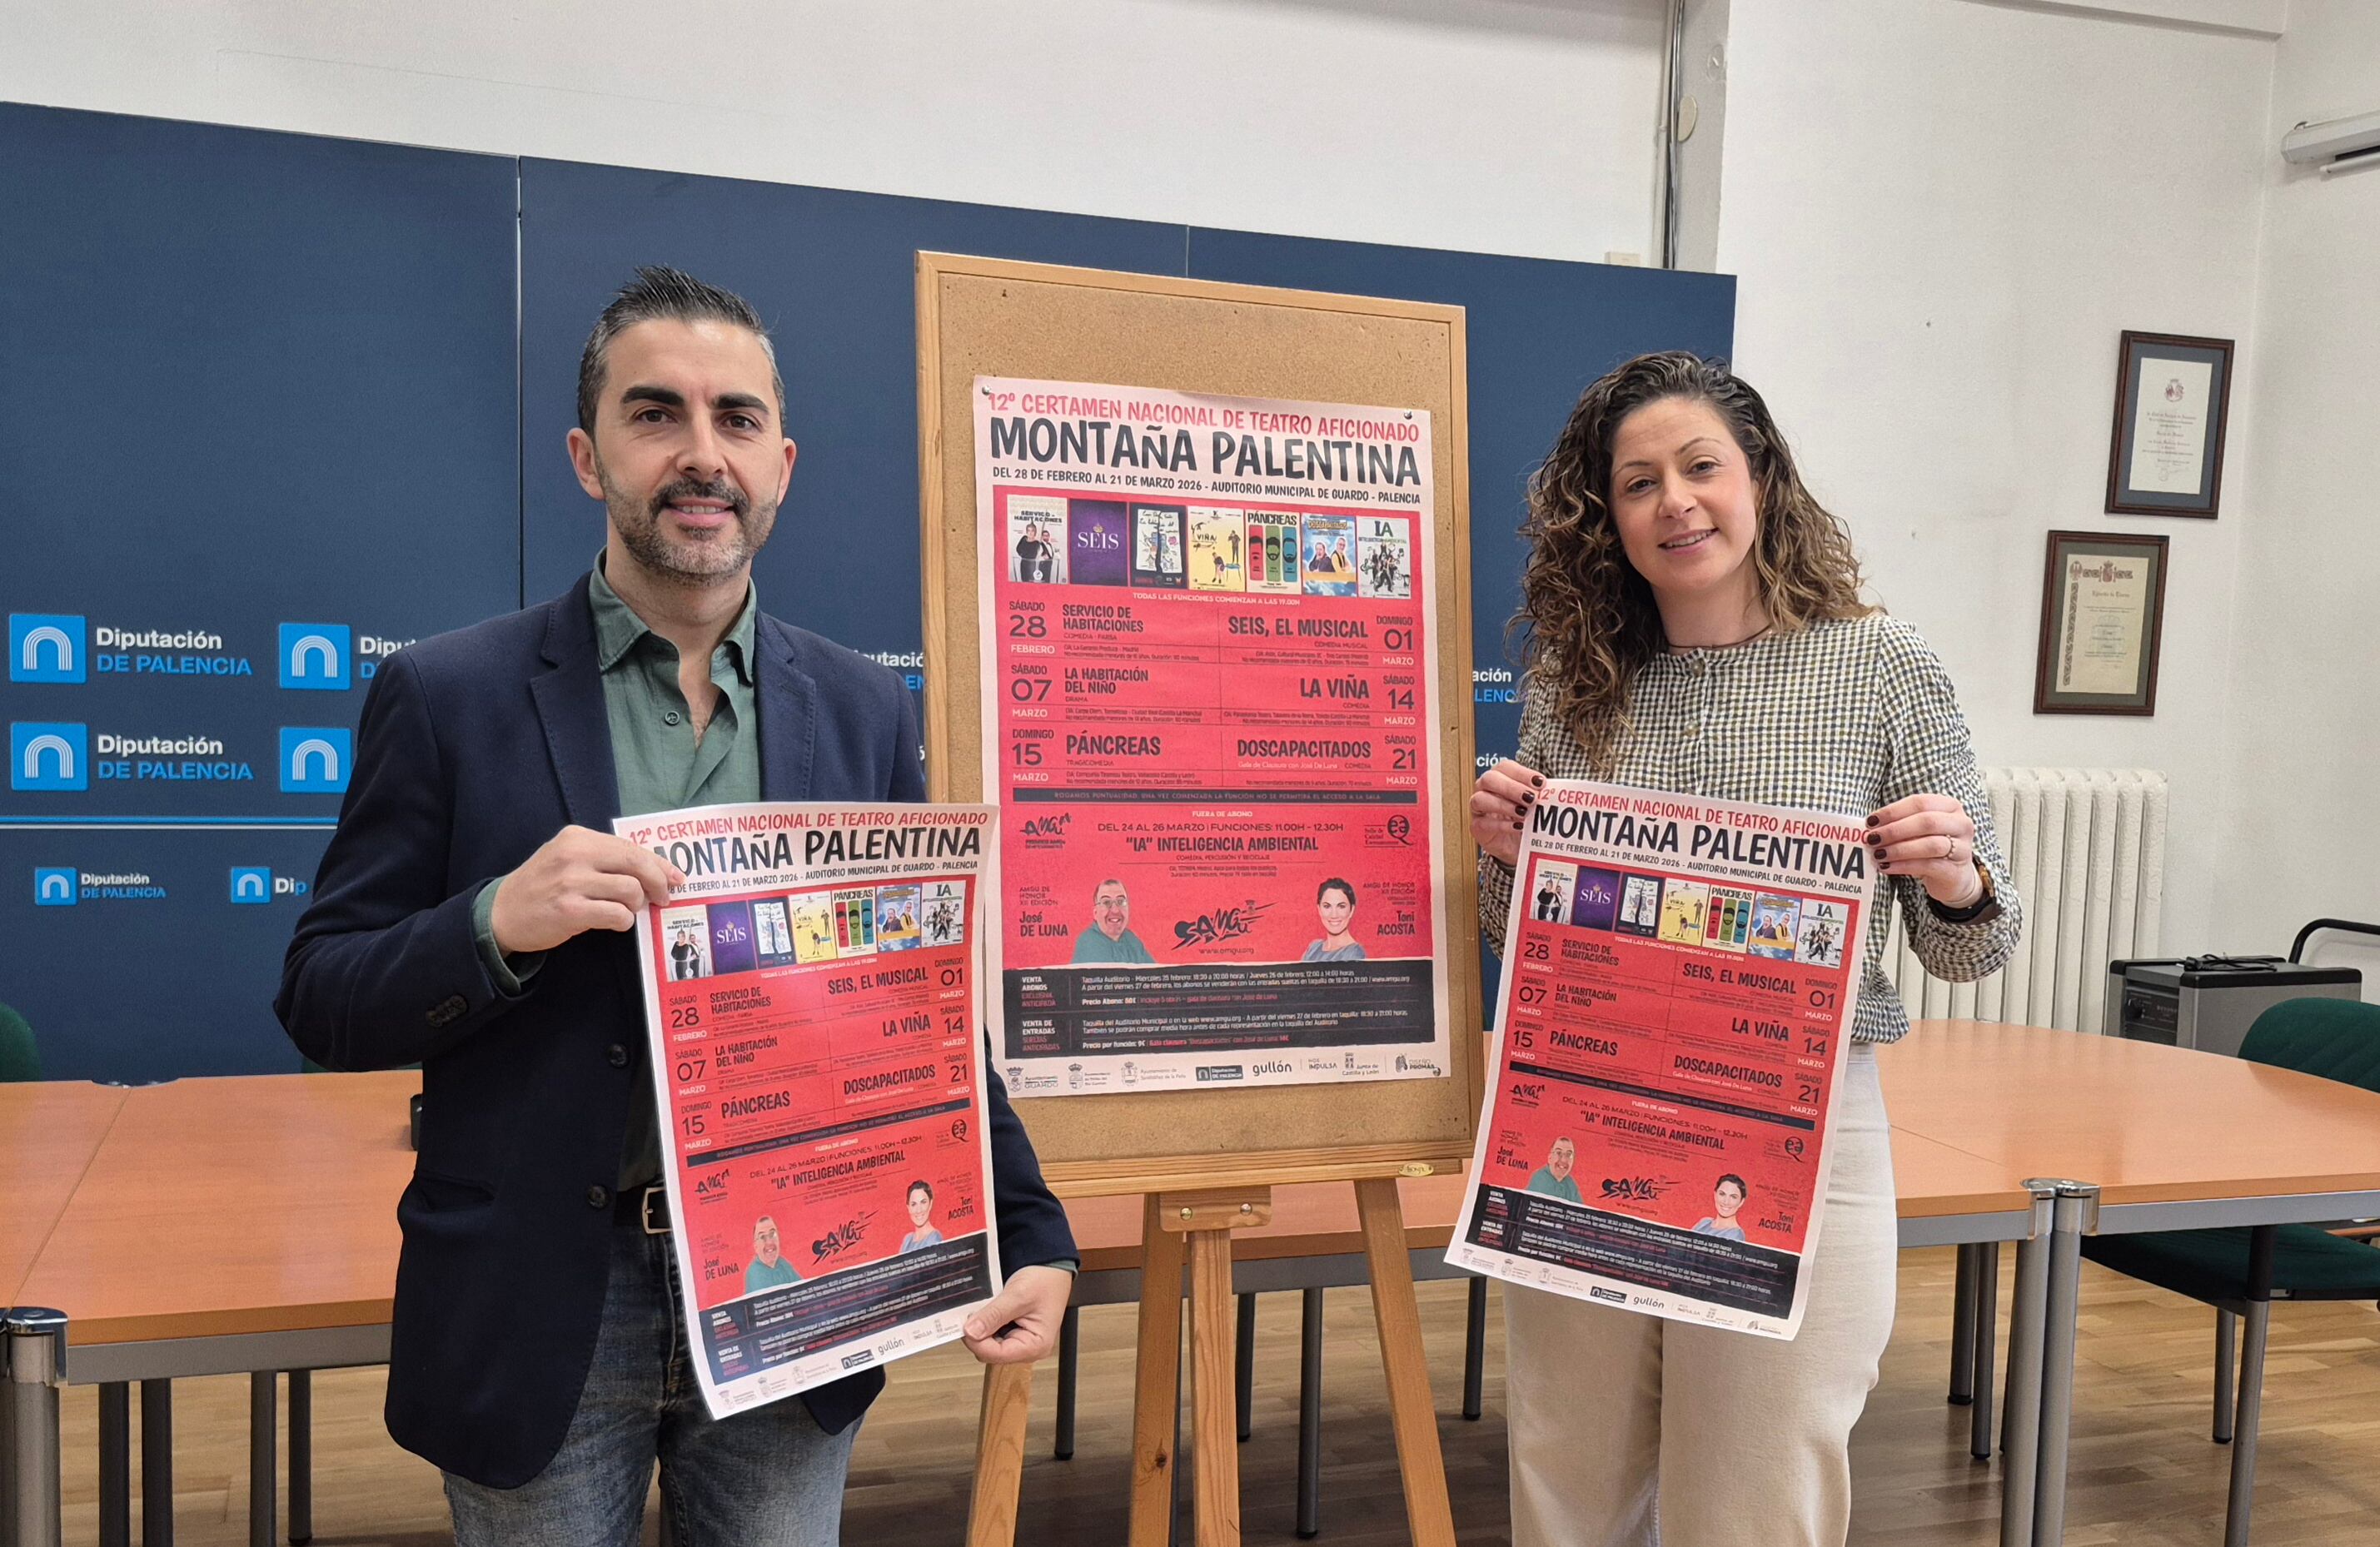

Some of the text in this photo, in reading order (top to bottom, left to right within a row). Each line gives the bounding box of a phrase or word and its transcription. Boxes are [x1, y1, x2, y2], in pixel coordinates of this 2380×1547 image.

[988, 392, 1420, 442] 12º CERTAMEN NACIONAL DE TEATRO AFICIONADO
[990, 416, 1422, 487] MONTAÑA PALENTINA
[993, 466, 1421, 504] DEL 28 DE FEBRERO AL 21 DE MARZO 2026 AUDITORIO MUNICIPAL DE GUARDO PALENCIA
[1247, 510, 1297, 526] PÁNCREAS
[1077, 531, 1119, 550] SEIS
[1008, 599, 1046, 612] SÁBADO
[1133, 592, 1158, 600] TODAS
[1215, 596, 1257, 604] COMIENZAN
[1063, 604, 1132, 619] SERVICIO DE
[1377, 614, 1413, 626] DOMINGO
[1009, 614, 1048, 639] 28
[1063, 618, 1144, 633] HABITACIONES
[1228, 616, 1368, 639] SEIS, EL MUSICAL
[96, 628, 222, 651] Diputación
[1011, 644, 1055, 654] FEBRERO
[1383, 629, 1413, 650] 01
[97, 654, 252, 675] DE PALENCIA
[1011, 664, 1048, 675] SÁBADO
[1382, 656, 1414, 666] MARZO
[1064, 666, 1148, 681] LA HABITACIÓN
[1383, 674, 1415, 685] SÁBADO
[1011, 678, 1053, 702] 07
[1064, 680, 1117, 694] DEL NIÑO
[1300, 674, 1370, 699] LA VIÑA
[1387, 688, 1415, 710] 14
[1012, 709, 1048, 718] MARZO
[1384, 716, 1416, 725] MARZO
[1012, 729, 1054, 739] DOMINGO
[1066, 730, 1161, 756] PÁNCREAS
[1385, 734, 1417, 746] SÁBADO
[97, 734, 223, 757] Diputación
[1012, 742, 1043, 766] 15
[1237, 739, 1372, 759] DOSCAPACITADOS
[1392, 749, 1417, 770] 21
[98, 761, 253, 780] DE PALENCIA
[1013, 773, 1049, 782] MARZO
[1386, 776, 1418, 785] MARZO
[1558, 788, 1630, 811] CERTAMEN
[1632, 799, 1701, 821] NACIONAL
[1705, 808, 1724, 824] DE
[1728, 811, 1778, 832] TEATRO
[657, 817, 733, 841] CERTAMEN
[737, 813, 812, 833] NACIONAL
[817, 813, 836, 827] DE
[840, 812, 894, 827] TEATRO
[899, 812, 988, 826] AFICIONADO
[1098, 823, 1119, 832] DEL
[1122, 823, 1133, 832] 24
[1135, 823, 1150, 832] AL
[1153, 823, 1165, 832] 26
[1167, 823, 1205, 832] MARZO
[1275, 823, 1305, 832] 11.00H
[1313, 823, 1344, 832] 12.30H
[805, 827, 980, 865] PALENTINA
[1158, 837, 1244, 851] INTELIGENCIA
[1248, 837, 1318, 851] AMBIENTAL
[1532, 804, 1865, 879] MONTAÑA PALENTINA
[1531, 838, 1862, 894] DEL 28 DE FEBRERO AL 21 DE MARZO 2026 AUDITORIO MUNICIPAL DE GUARDO PALENCIA
[81, 873, 150, 886] Diputación
[81, 887, 166, 899] DE PALENCIA
[1019, 911, 1043, 924] José
[1397, 910, 1415, 922] Toni
[1020, 924, 1068, 937] DE LUNA
[1377, 923, 1416, 936] ACOSTA
[1524, 942, 1550, 960] 28
[828, 967, 929, 995] SEIS, EL MUSICAL
[941, 967, 963, 986] 01
[1683, 963, 1796, 994] SEIS, EL MUSICAL
[1519, 986, 1548, 1004] 07
[1810, 991, 1835, 1009] 01
[671, 1007, 700, 1028] 28
[944, 1016, 965, 1034] 14
[1513, 1030, 1533, 1047] 15
[1550, 1028, 1618, 1056] PÁNCREAS
[1805, 1037, 1826, 1056] 14
[677, 1060, 707, 1082] 07
[950, 1064, 968, 1082] 21
[1252, 1059, 1292, 1077] gullón
[1674, 1055, 1783, 1087] DOSCAPACITADOS
[844, 1064, 935, 1095] DOSCAPACITADOS
[1798, 1085, 1820, 1104] 21
[721, 1091, 790, 1118] PÁNCREAS
[682, 1115, 705, 1136] 15
[1633, 1296, 1665, 1310] gullón
[878, 1337, 905, 1356] gullón
